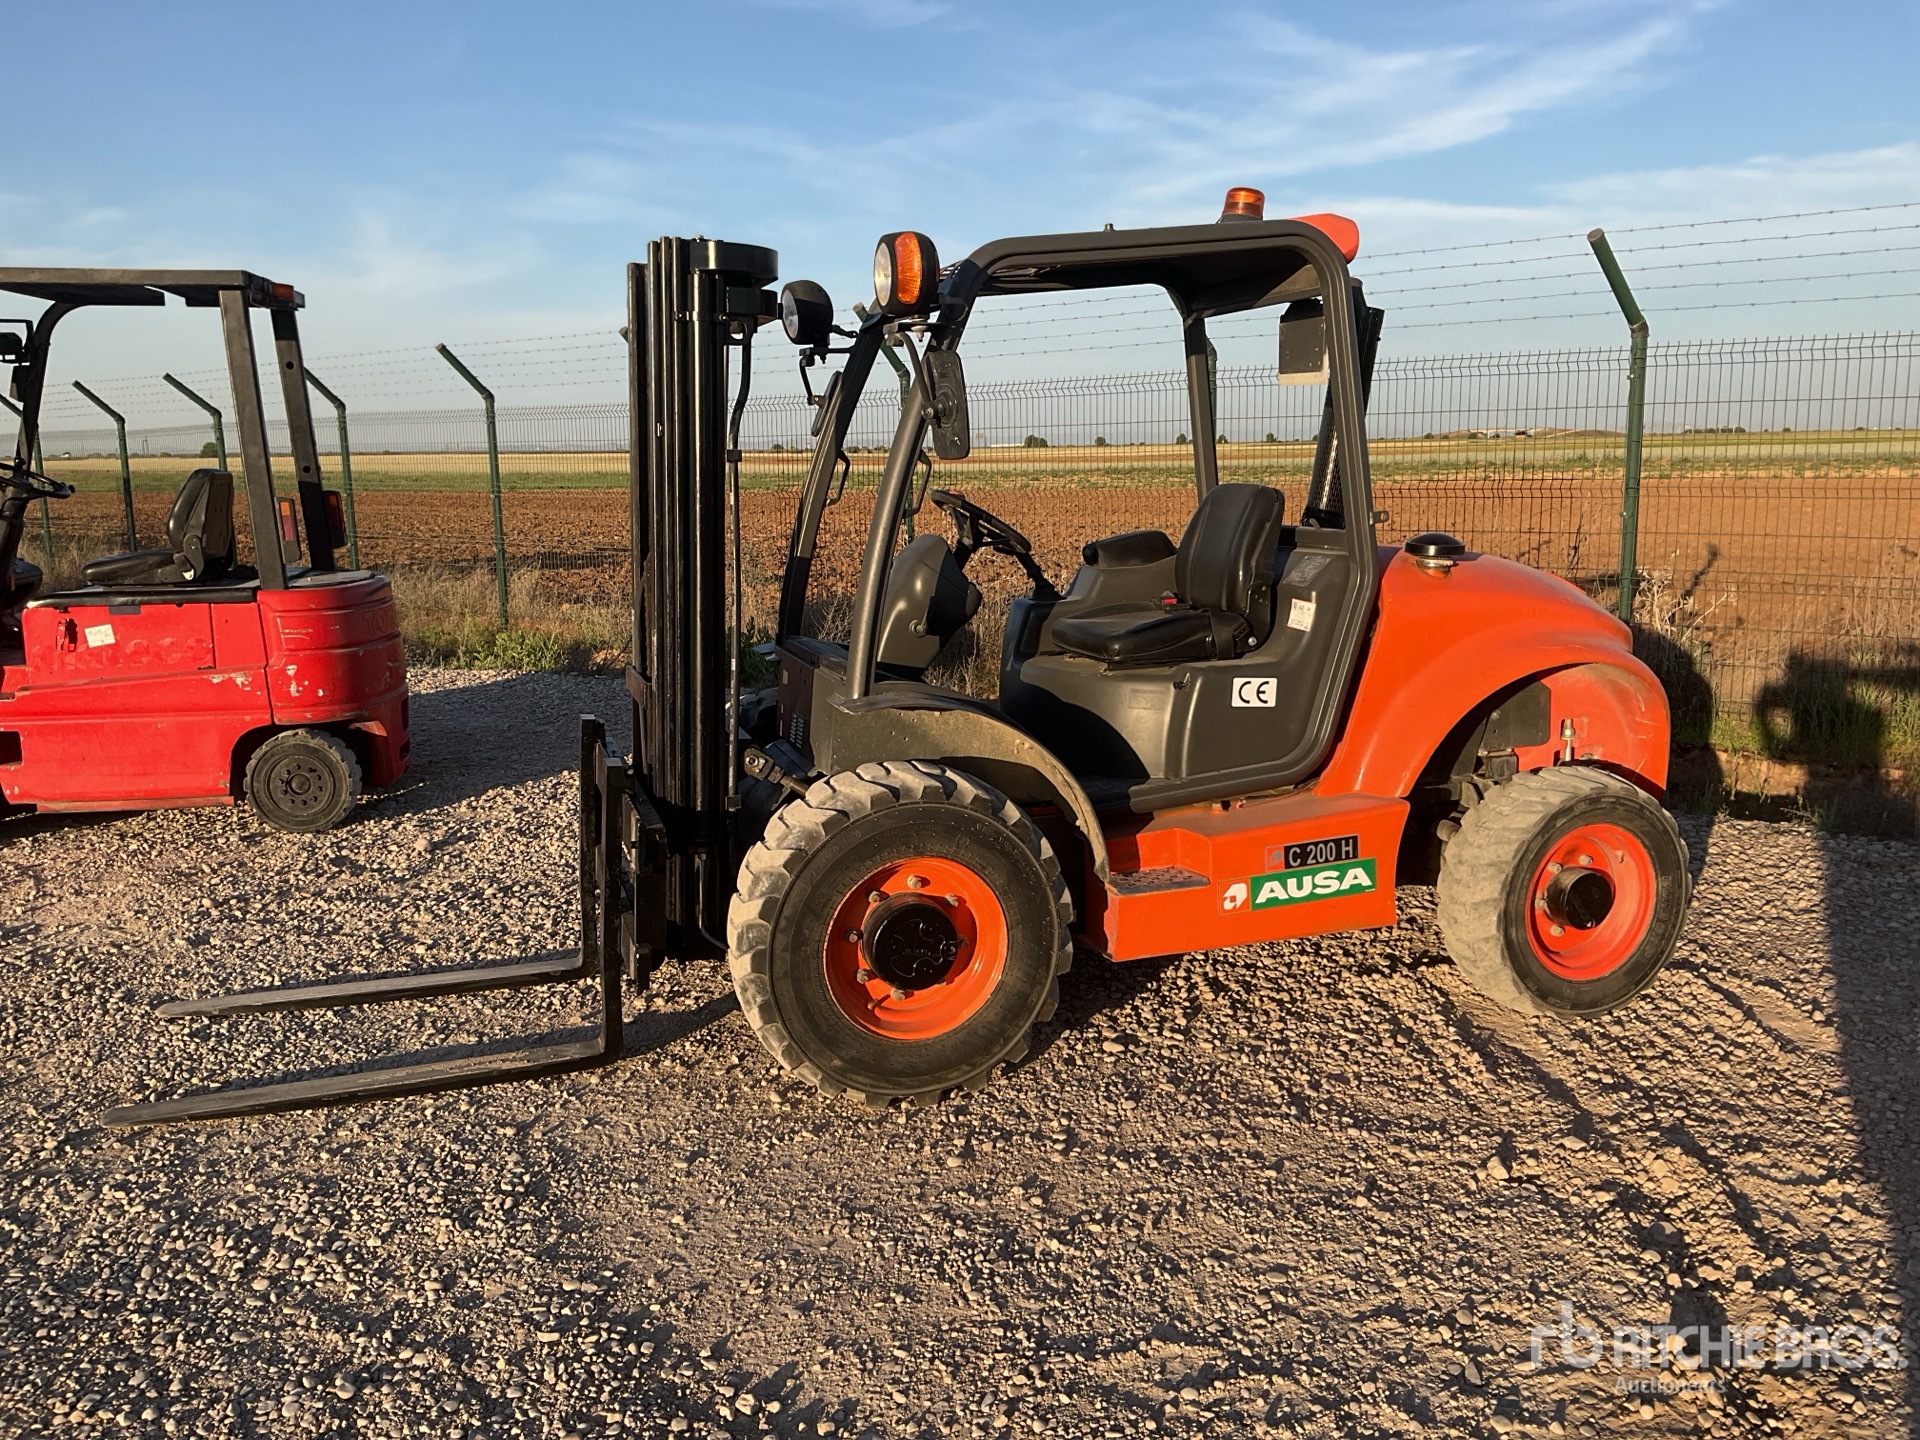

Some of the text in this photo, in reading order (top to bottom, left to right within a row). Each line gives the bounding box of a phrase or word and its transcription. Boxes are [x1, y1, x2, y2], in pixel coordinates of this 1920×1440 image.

[1238, 681, 1270, 704] CE
[1288, 838, 1353, 867] C 200 H
[1255, 867, 1373, 904] AUSA
